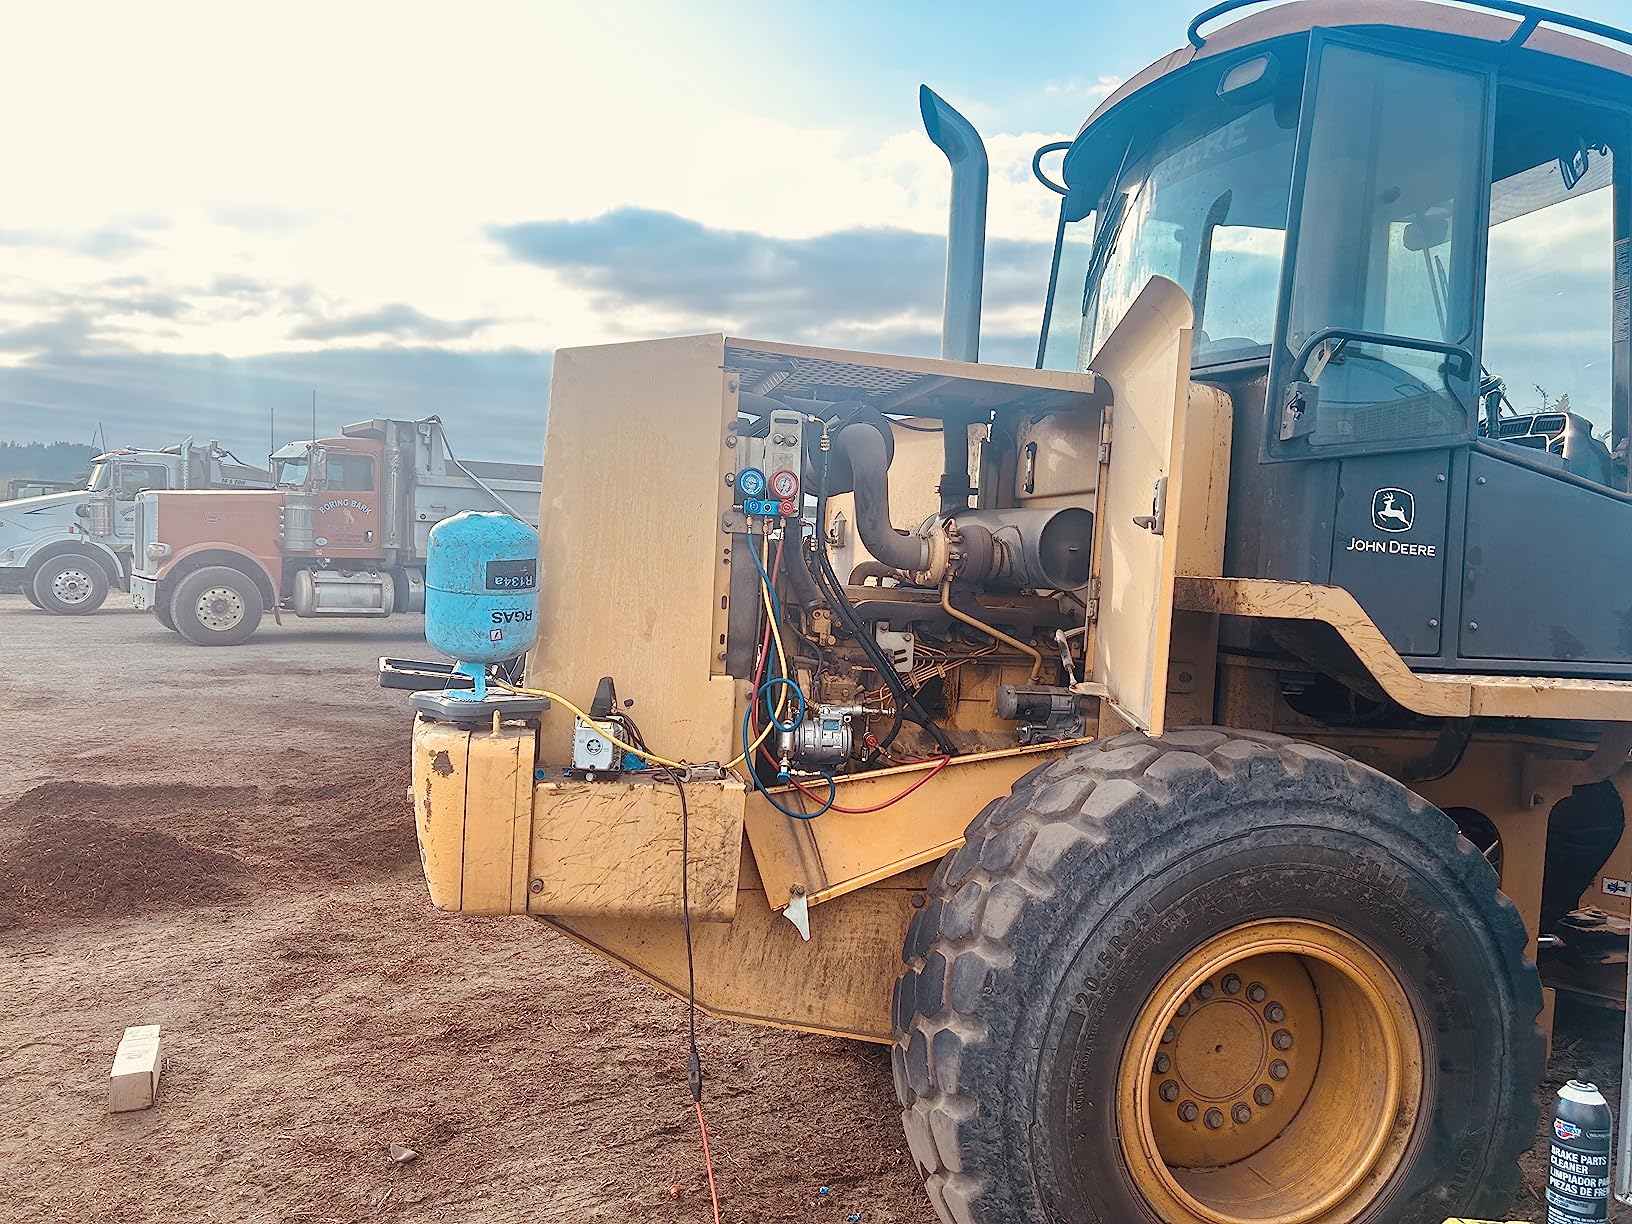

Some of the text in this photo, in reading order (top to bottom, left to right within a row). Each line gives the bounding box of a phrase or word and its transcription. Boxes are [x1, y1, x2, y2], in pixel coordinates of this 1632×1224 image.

[319, 498, 372, 515] BORING BARK
[1346, 537, 1436, 557] JOHN DEERE
[493, 575, 534, 587] R134a
[1551, 1144, 1607, 1165] BRAKE PARTS
[1550, 1155, 1589, 1175] CLEANER
[1549, 1165, 1597, 1187] LIMPIADOR
[1549, 1175, 1578, 1194] PIEZAS
[1579, 1187, 1594, 1197] DE
